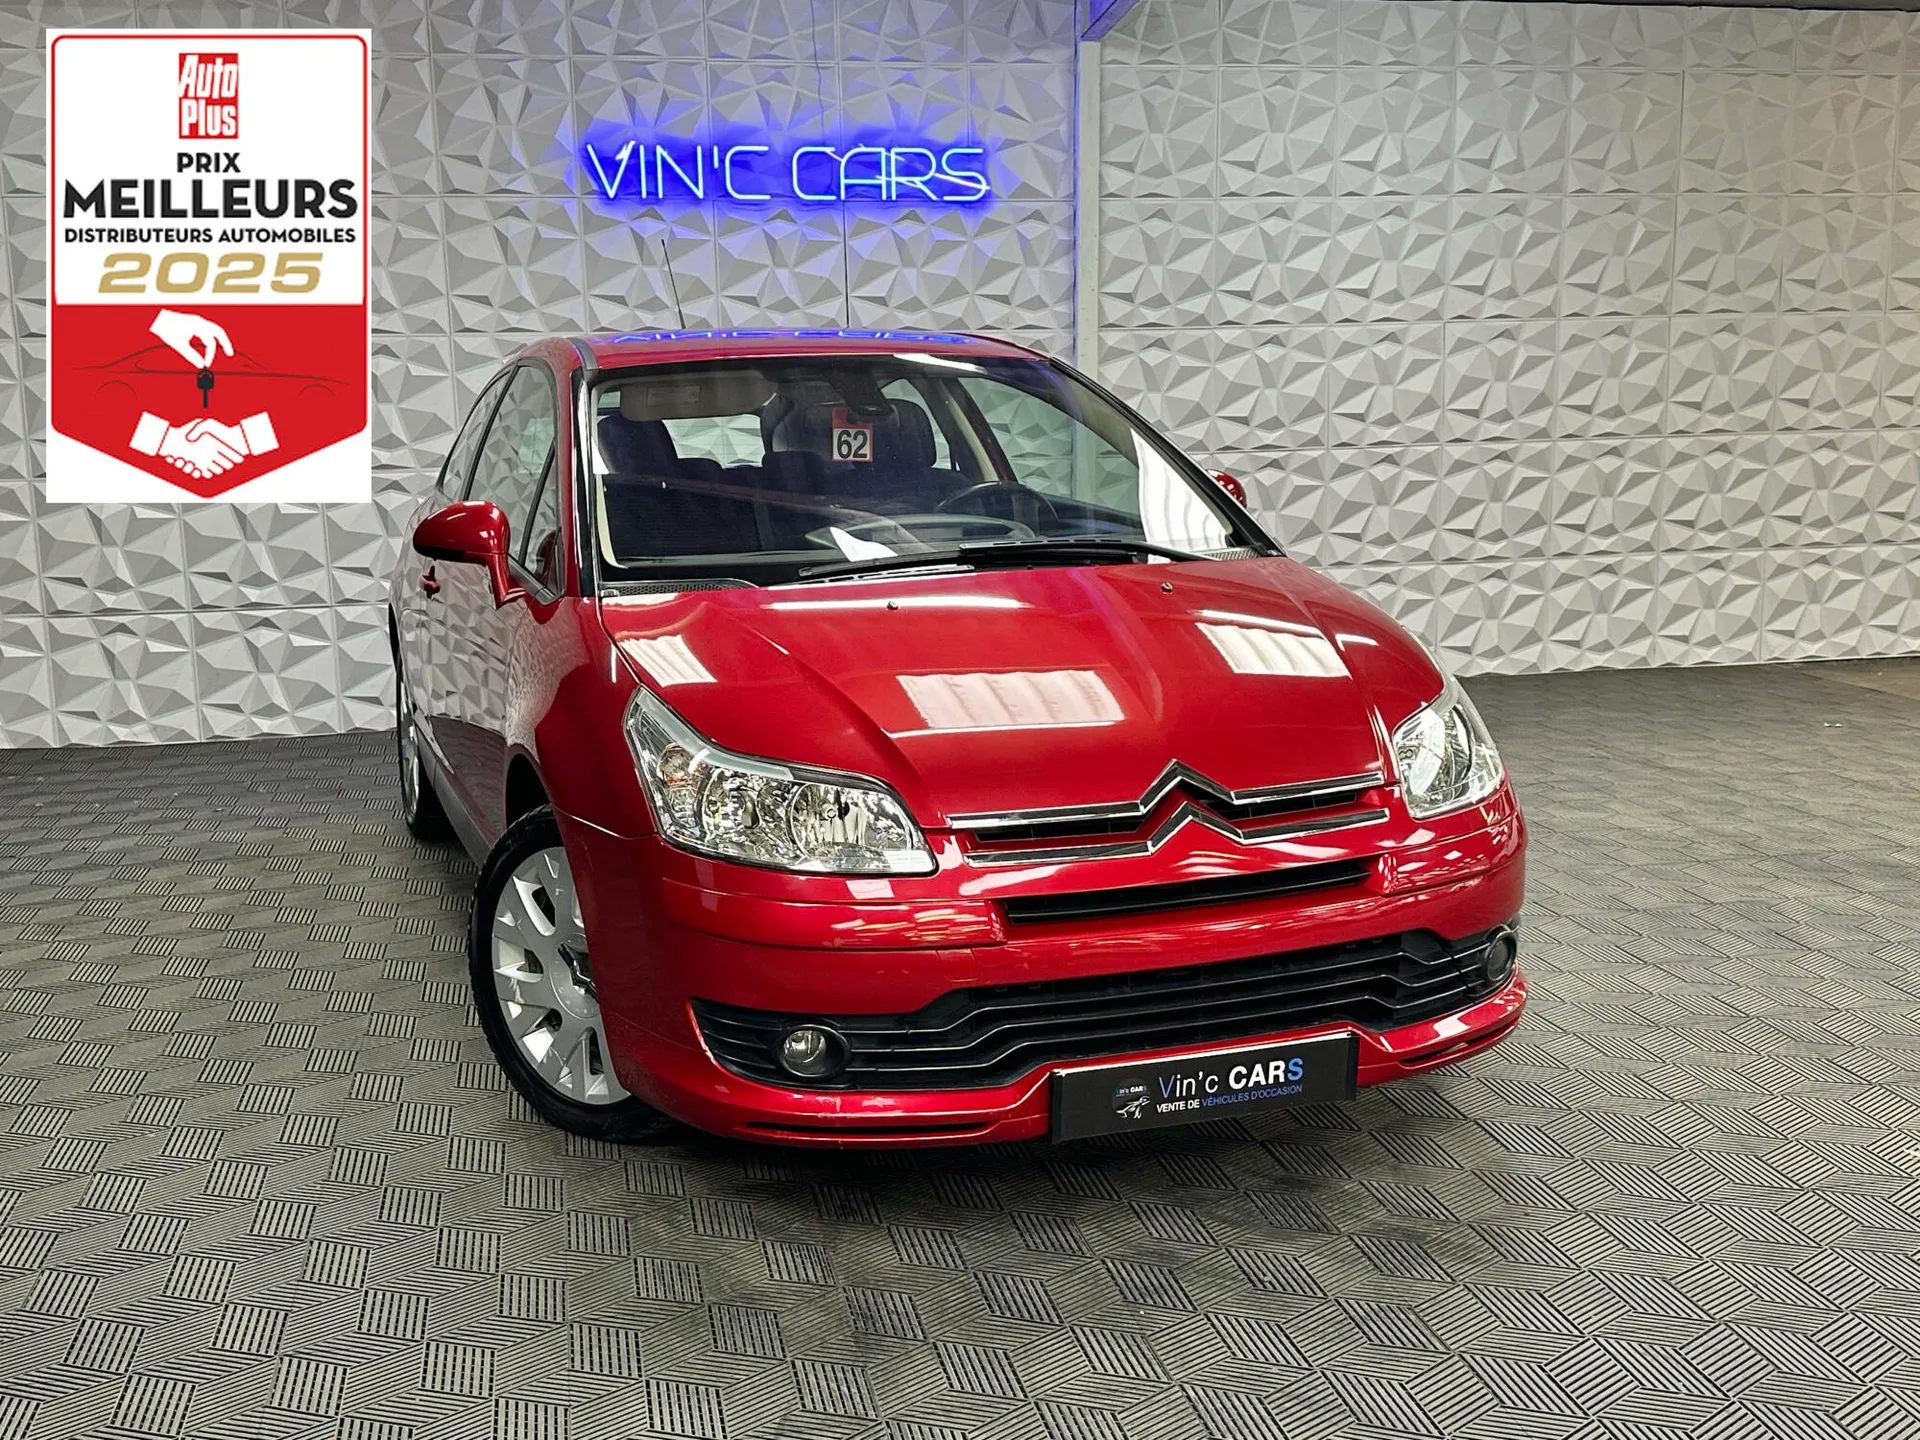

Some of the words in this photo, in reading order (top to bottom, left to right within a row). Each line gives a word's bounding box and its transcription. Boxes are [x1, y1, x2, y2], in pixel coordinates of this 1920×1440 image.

[586, 140, 770, 200] VIN'C
[791, 145, 988, 201] CARS
[837, 429, 868, 459] 62
[1158, 1071, 1219, 1099] Vin'c
[1228, 1057, 1304, 1090] CARS
[1156, 1100, 1186, 1113] VENTE
[1187, 1099, 1200, 1109] DE
[1201, 1091, 1250, 1107] VÉHICULES
[1250, 1084, 1303, 1100] D'OCCASION
